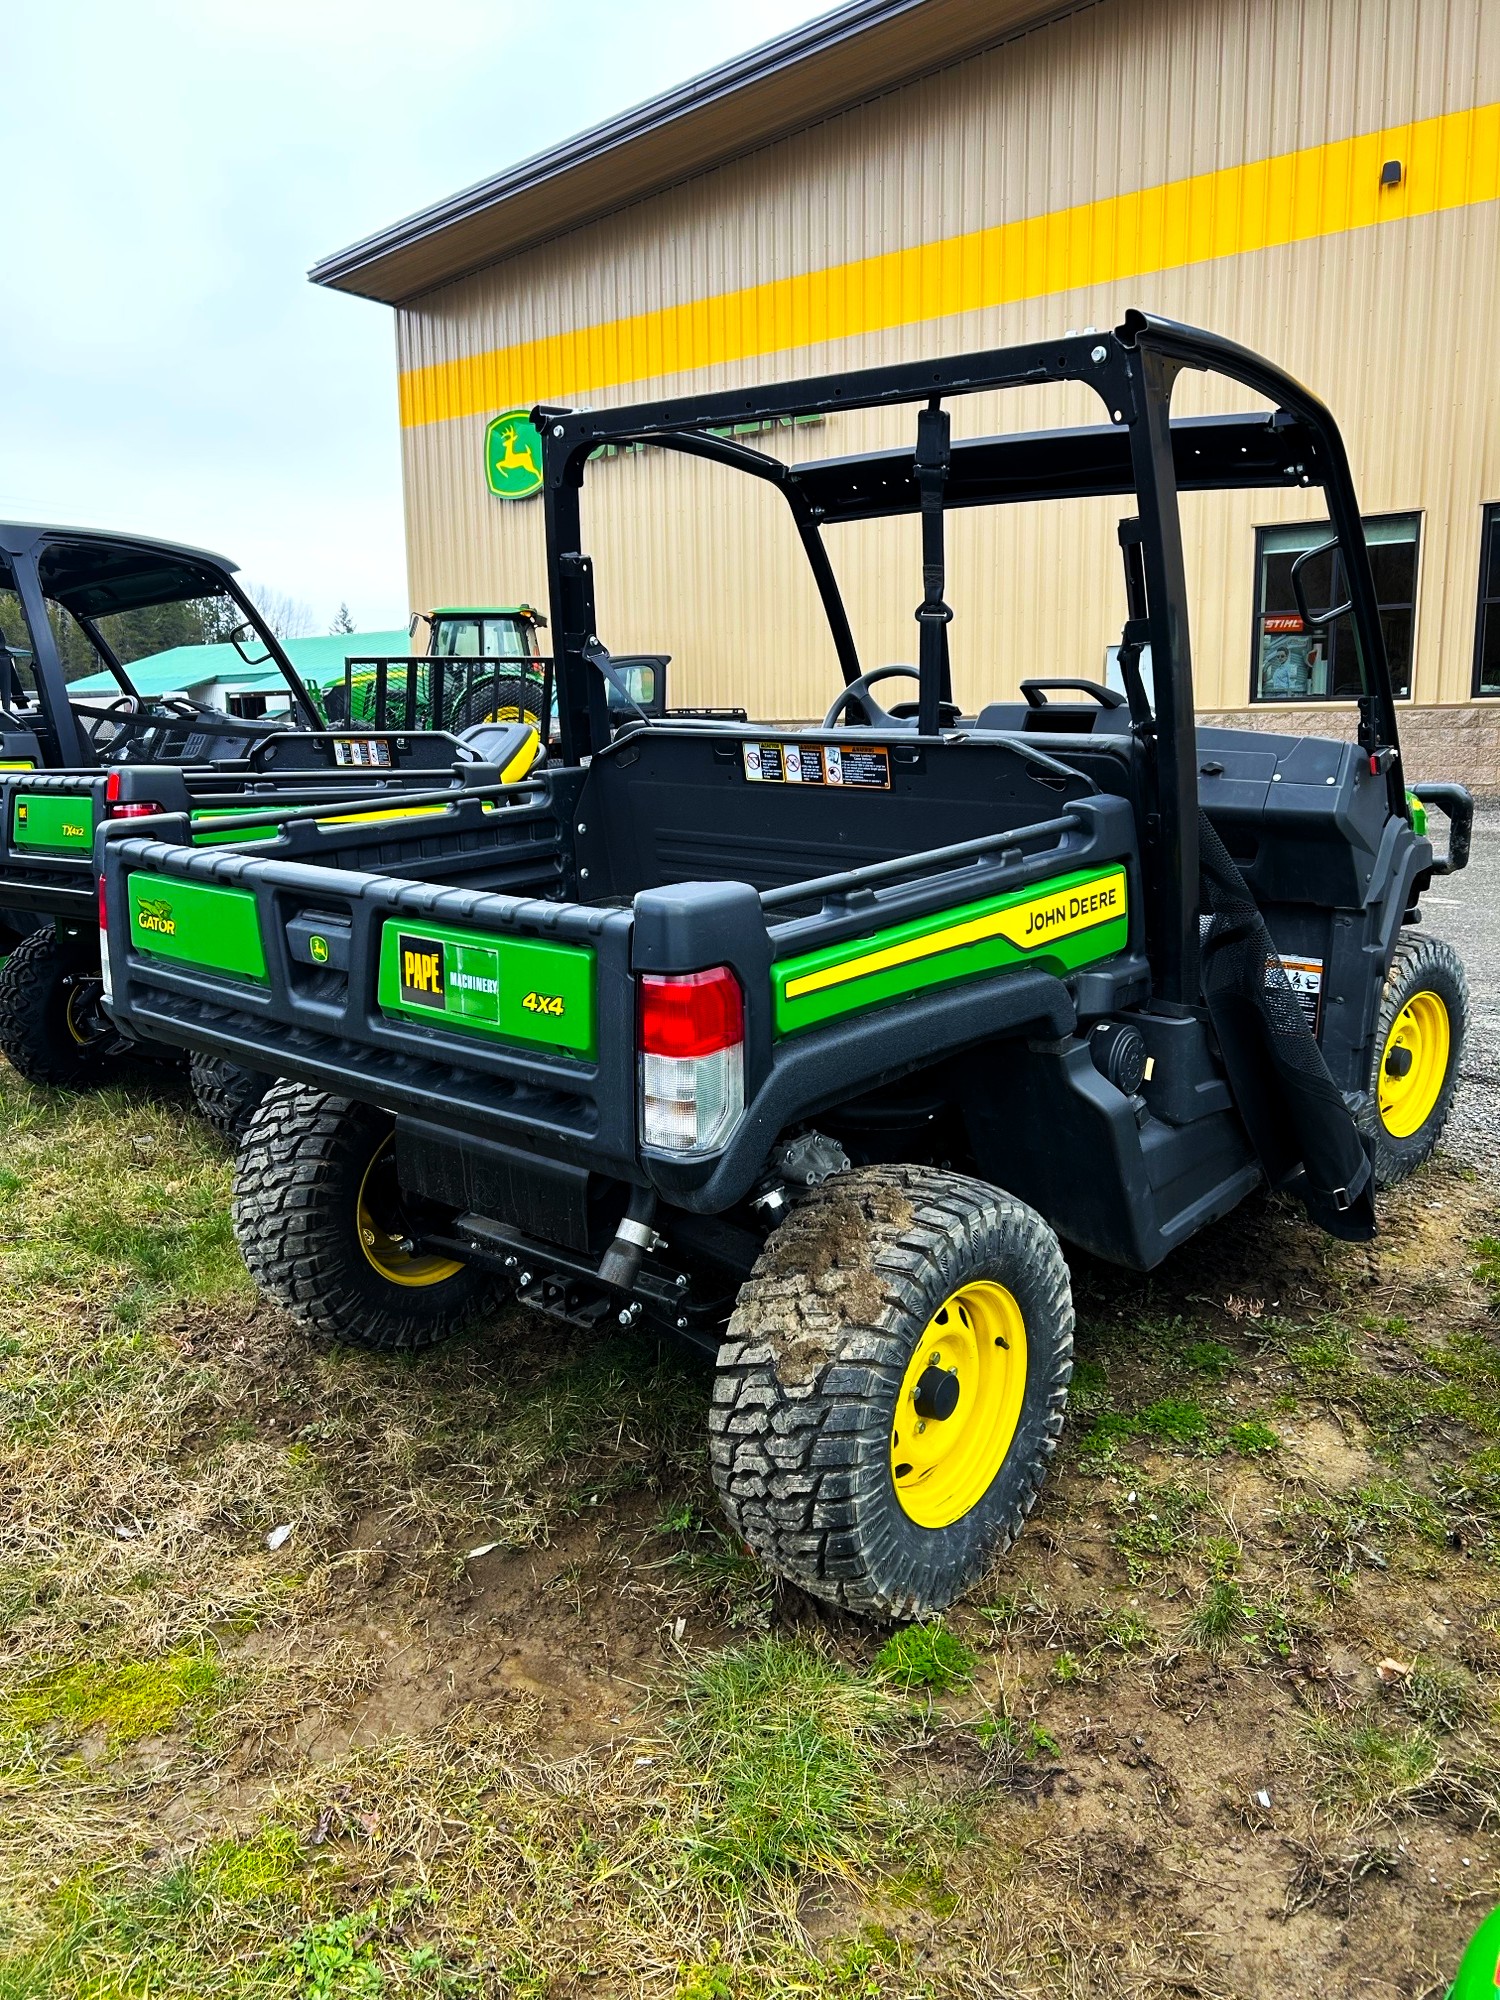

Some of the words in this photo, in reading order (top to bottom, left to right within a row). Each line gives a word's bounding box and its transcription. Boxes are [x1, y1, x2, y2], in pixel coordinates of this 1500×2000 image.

[1265, 619, 1301, 628] STIHL
[1026, 905, 1066, 935] JOHN
[1069, 888, 1117, 919] DEERE
[138, 912, 175, 935] GATOR
[450, 971, 498, 994] MACHINERY
